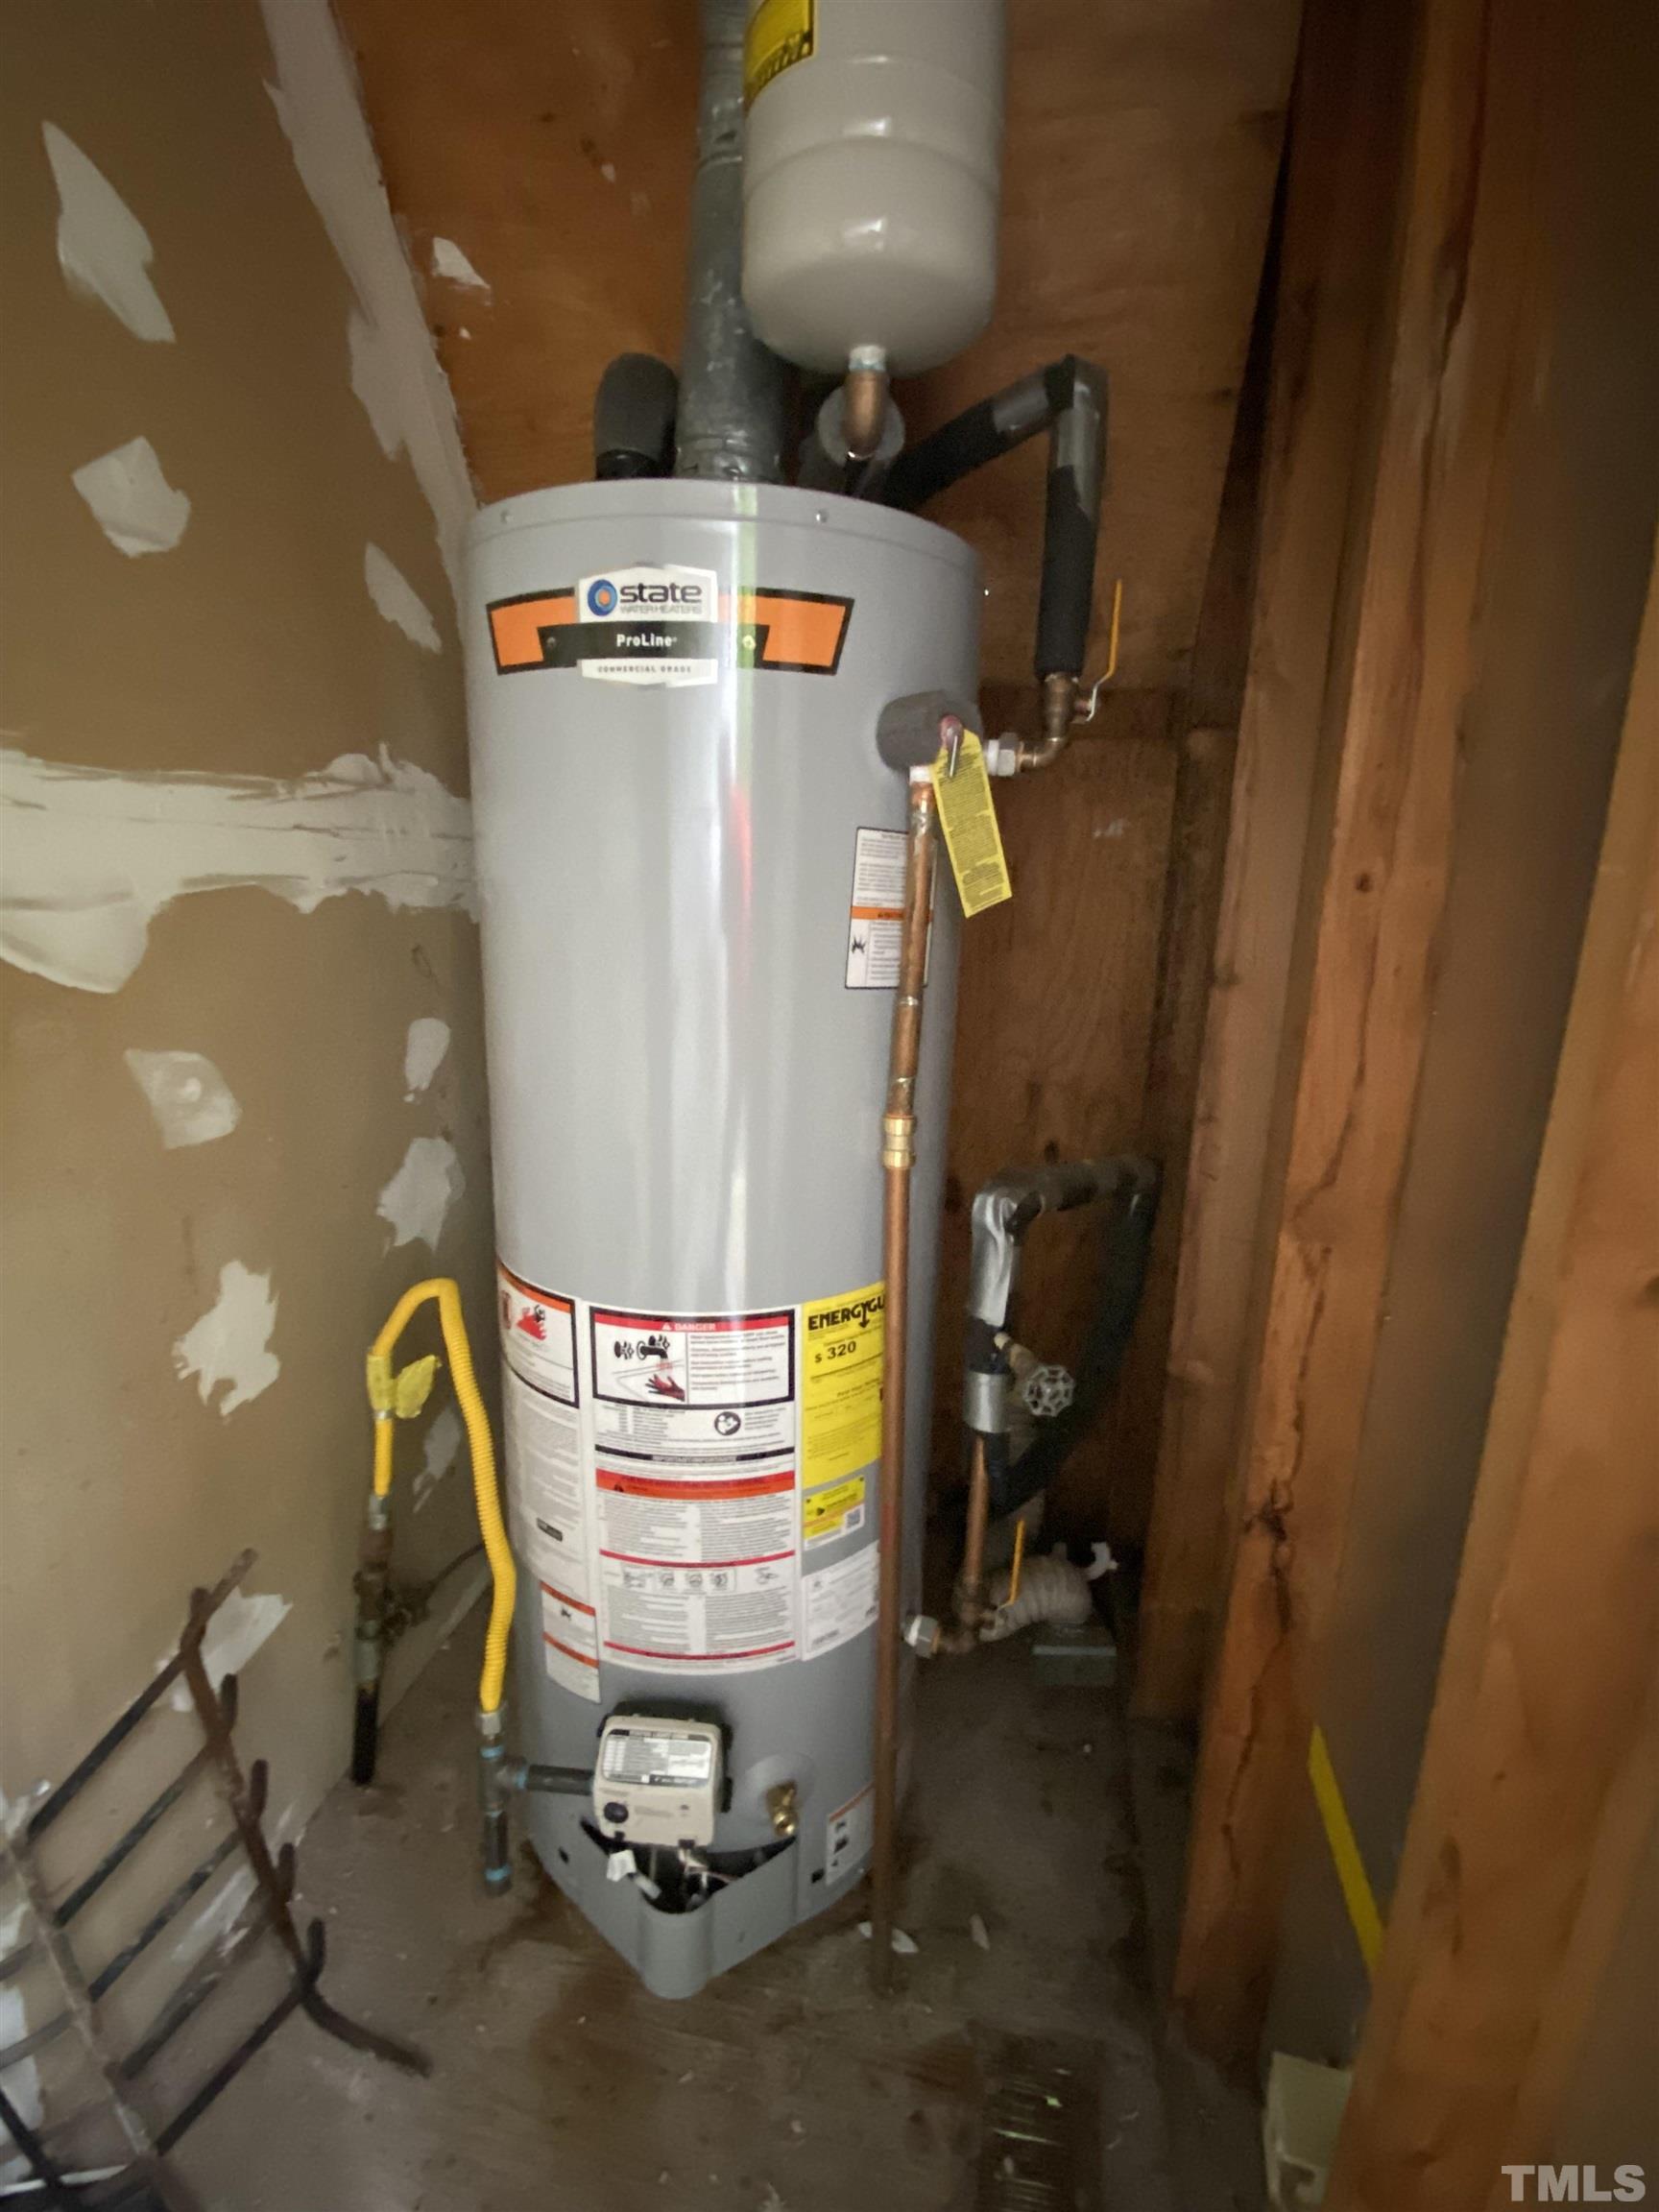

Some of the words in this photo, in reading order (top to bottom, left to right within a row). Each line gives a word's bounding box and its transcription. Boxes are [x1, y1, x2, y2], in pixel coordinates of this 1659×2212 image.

[619, 582, 703, 604] state
[674, 1322, 717, 1332] DANGER
[827, 1340, 857, 1360] 320
